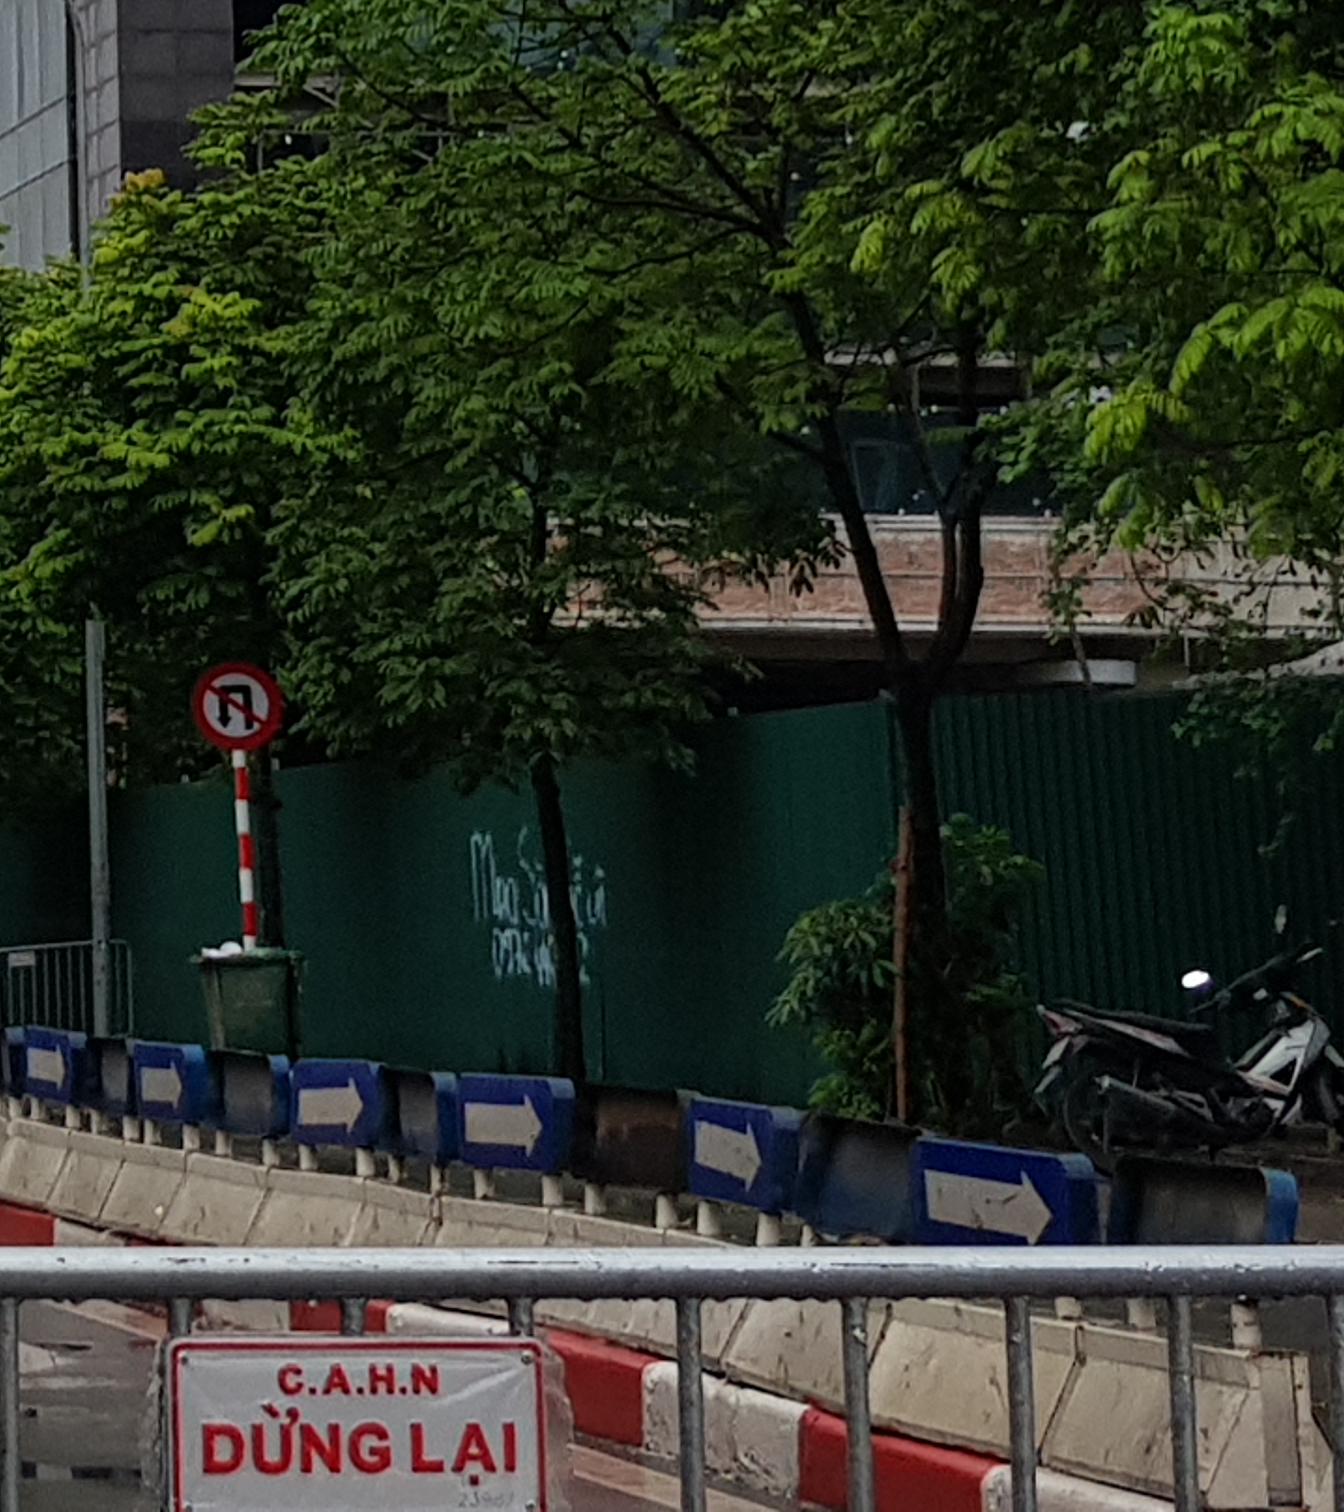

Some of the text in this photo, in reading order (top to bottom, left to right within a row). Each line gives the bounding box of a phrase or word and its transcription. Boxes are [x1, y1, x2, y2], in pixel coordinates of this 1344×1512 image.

[277, 1363, 440, 1396] C.A.H.N
[201, 1402, 517, 1486] DỪNG LẠI
